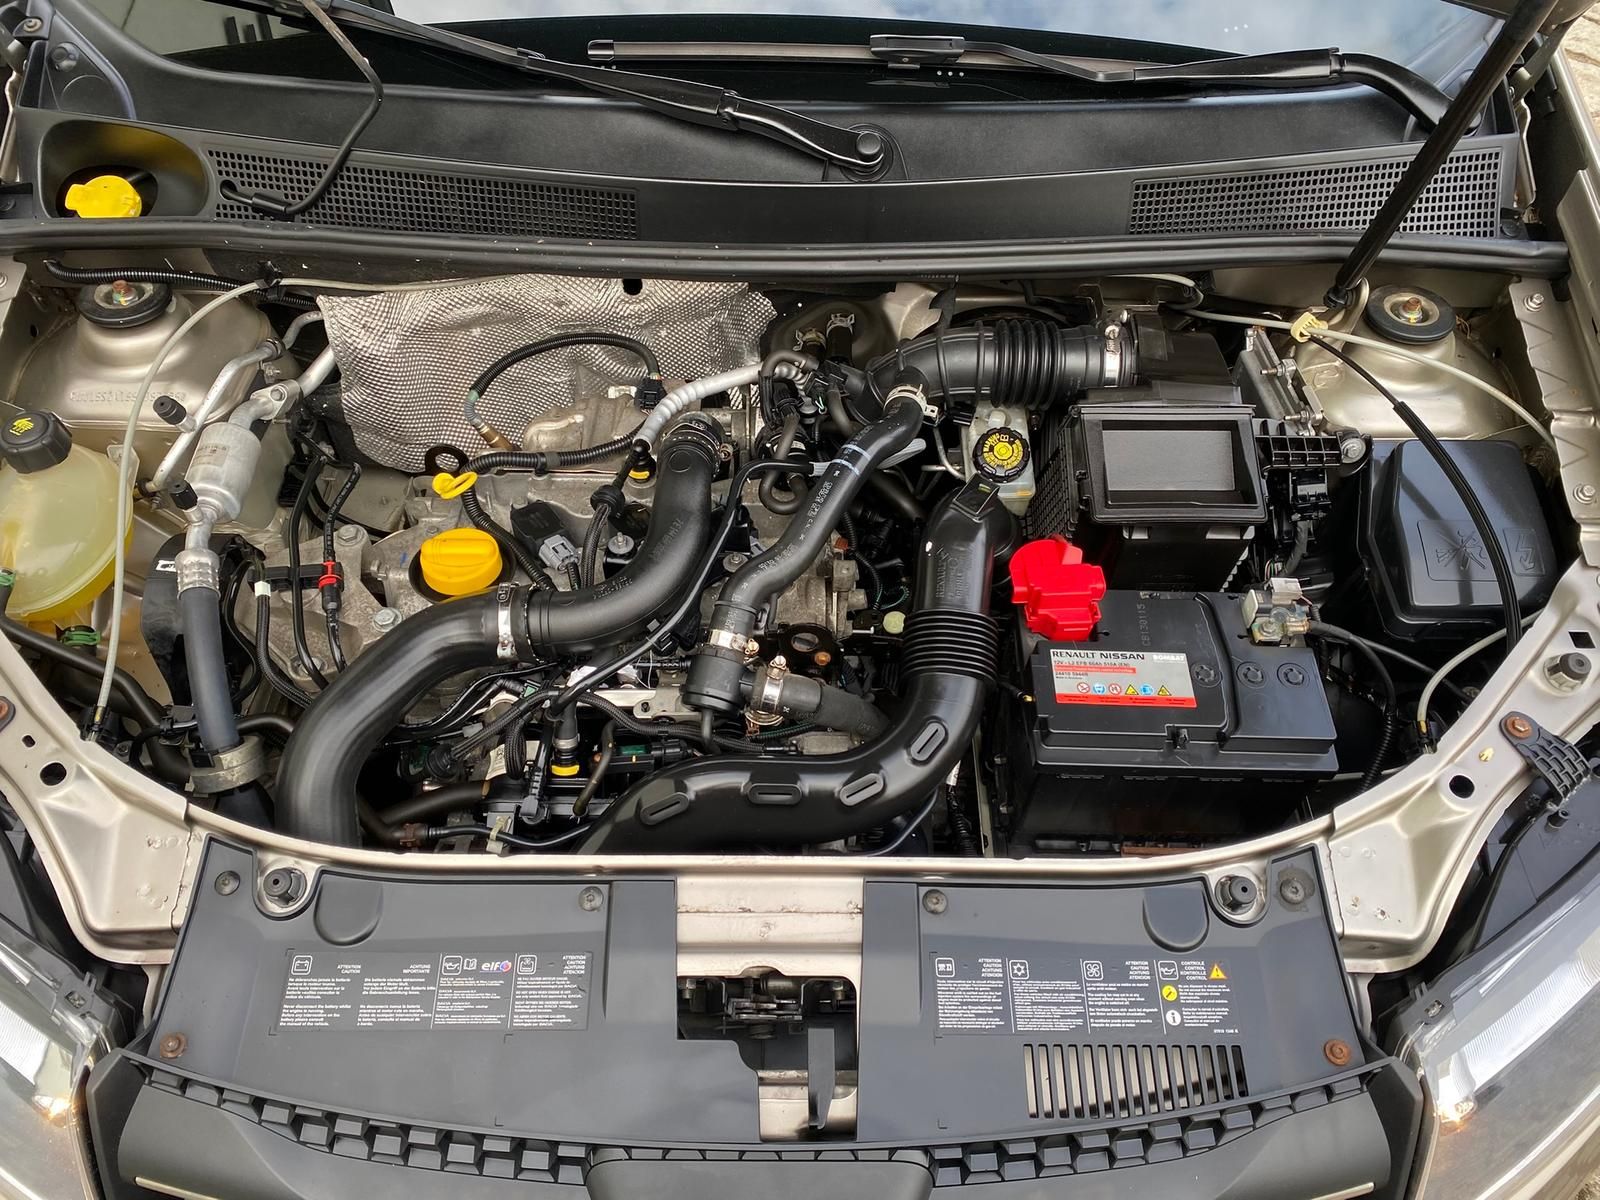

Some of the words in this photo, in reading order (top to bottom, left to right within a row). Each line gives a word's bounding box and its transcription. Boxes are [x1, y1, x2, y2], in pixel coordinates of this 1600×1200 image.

[1052, 651, 1097, 659] RENAULT
[1100, 652, 1145, 660] NISSAN
[481, 961, 501, 971] elf
